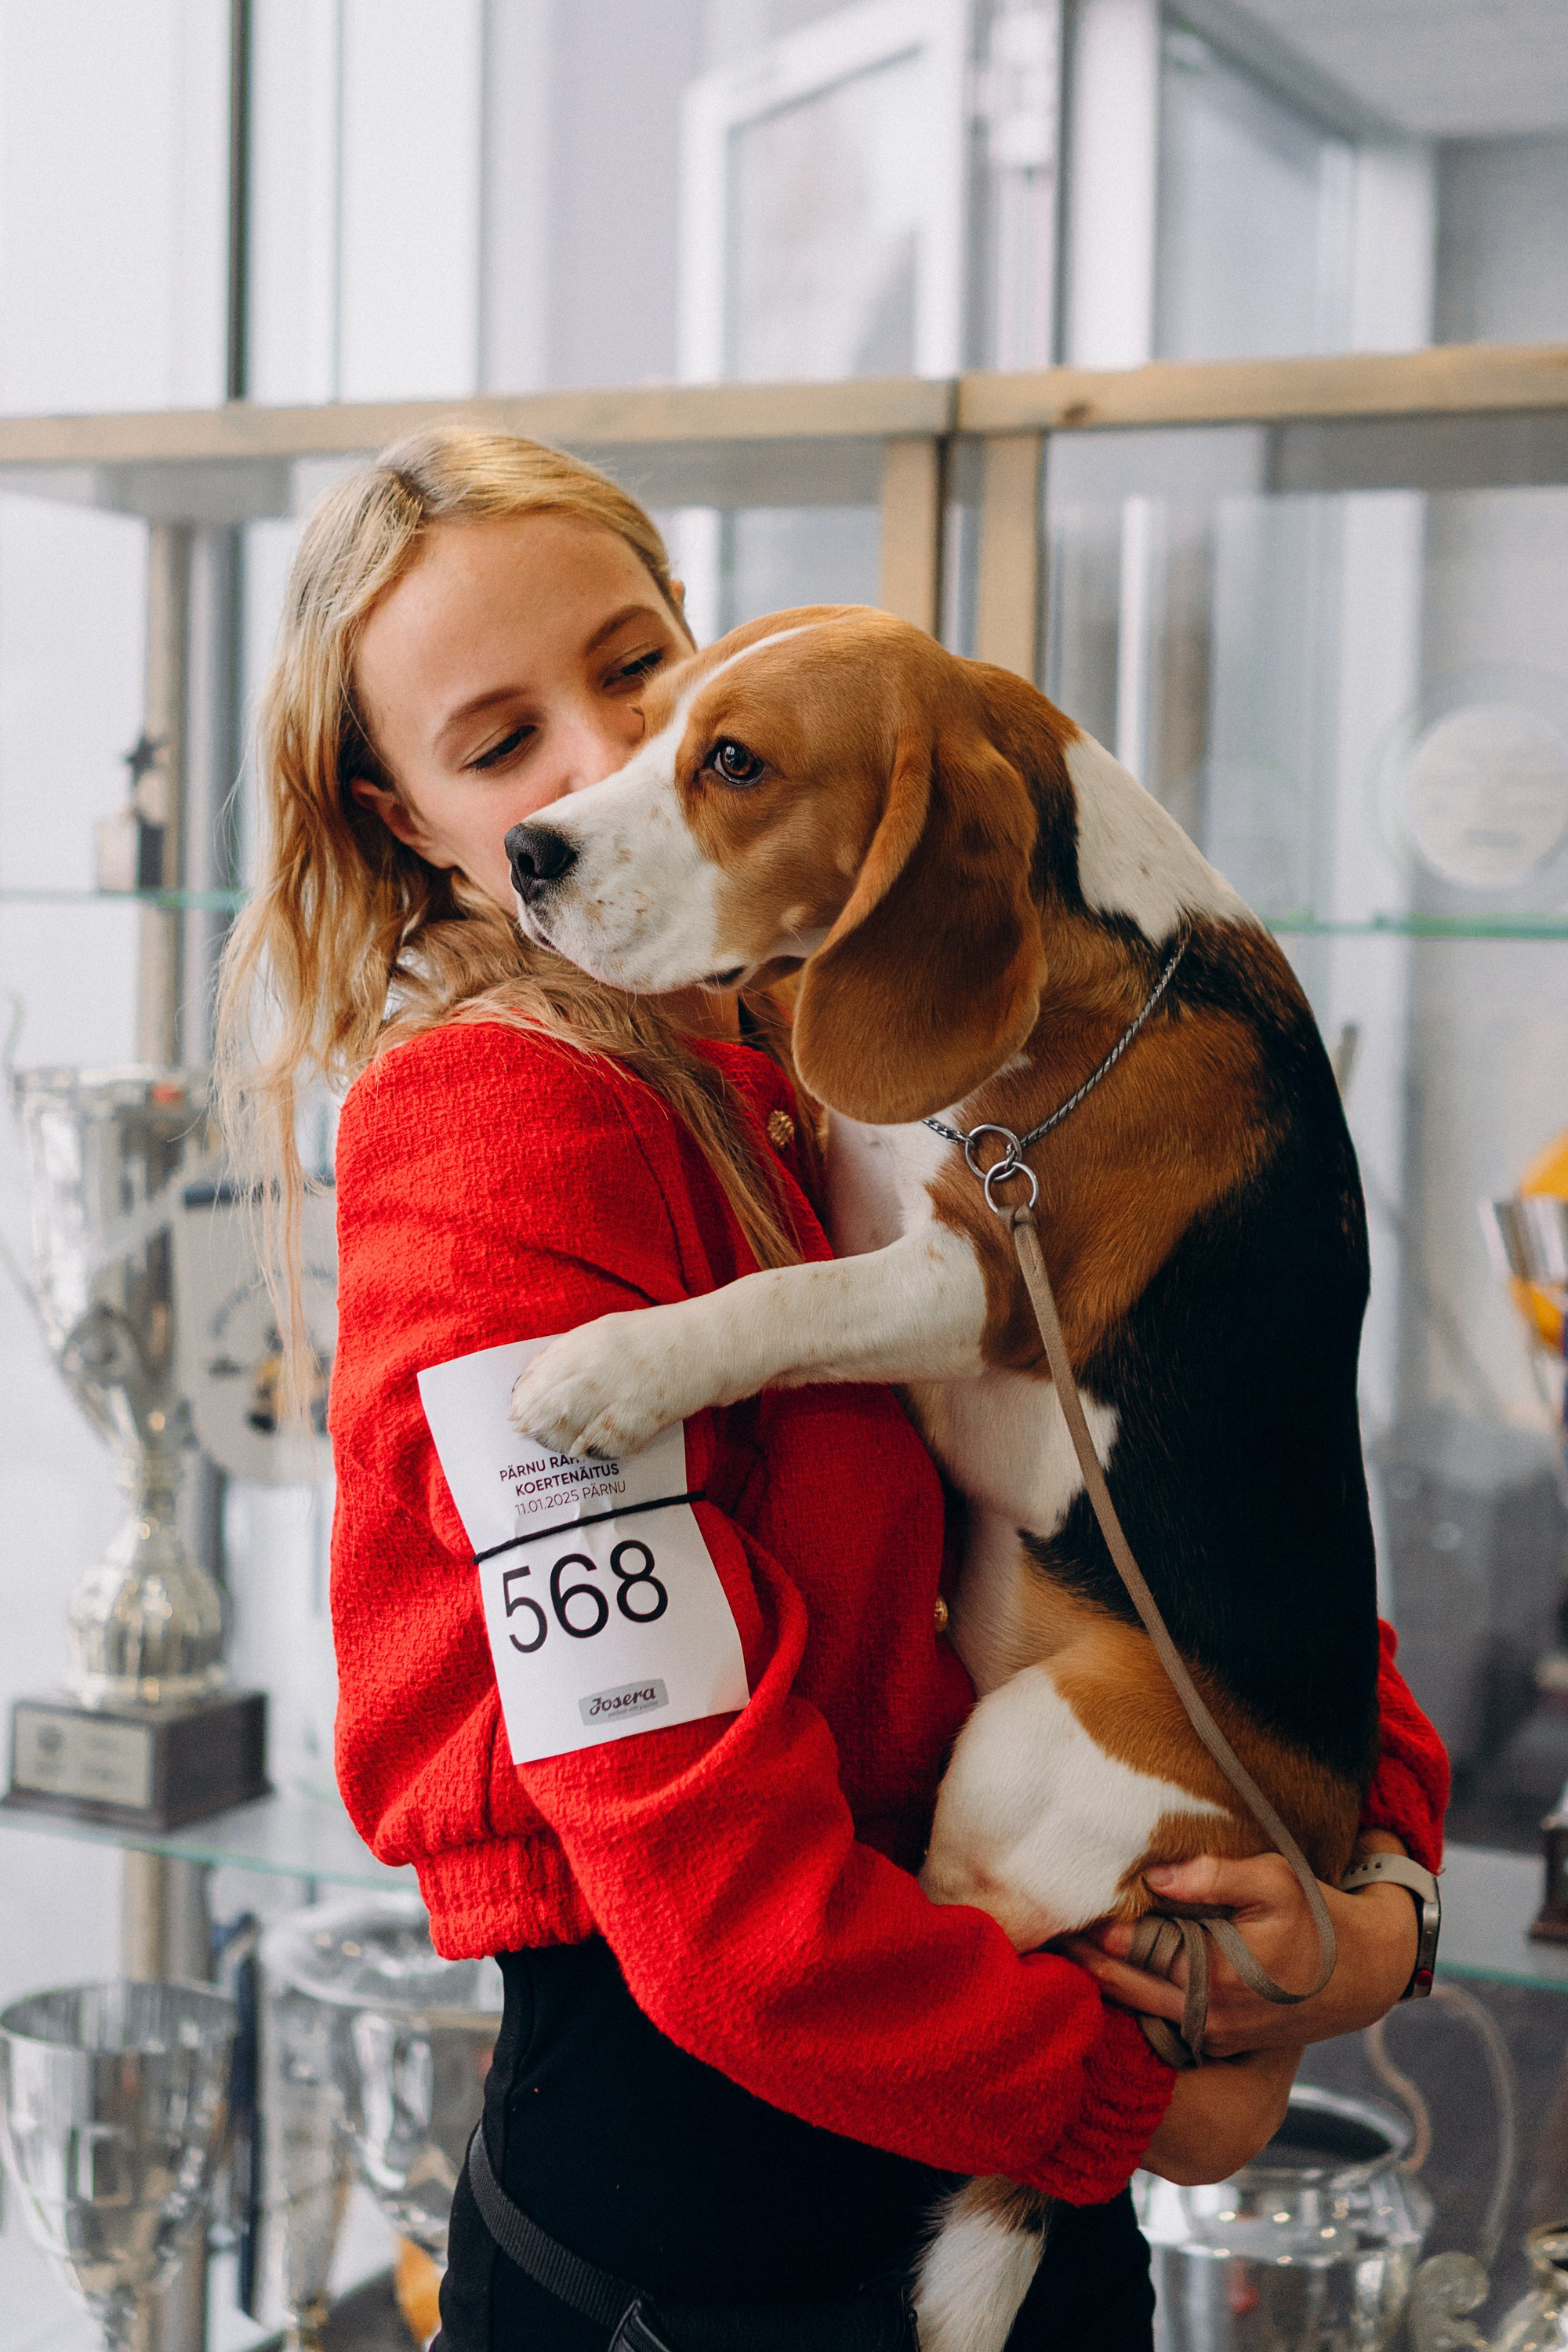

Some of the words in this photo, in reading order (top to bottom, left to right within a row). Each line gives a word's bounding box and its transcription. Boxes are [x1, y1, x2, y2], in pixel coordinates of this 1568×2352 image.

[499, 1459, 546, 1482] PÄRNU
[515, 1463, 619, 1497] KOERTENÄITUS
[515, 1489, 579, 1515] 11.01.2025
[582, 1480, 626, 1499] PÄRNU
[503, 1539, 669, 1653] 568
[589, 1687, 656, 1715] Josera
